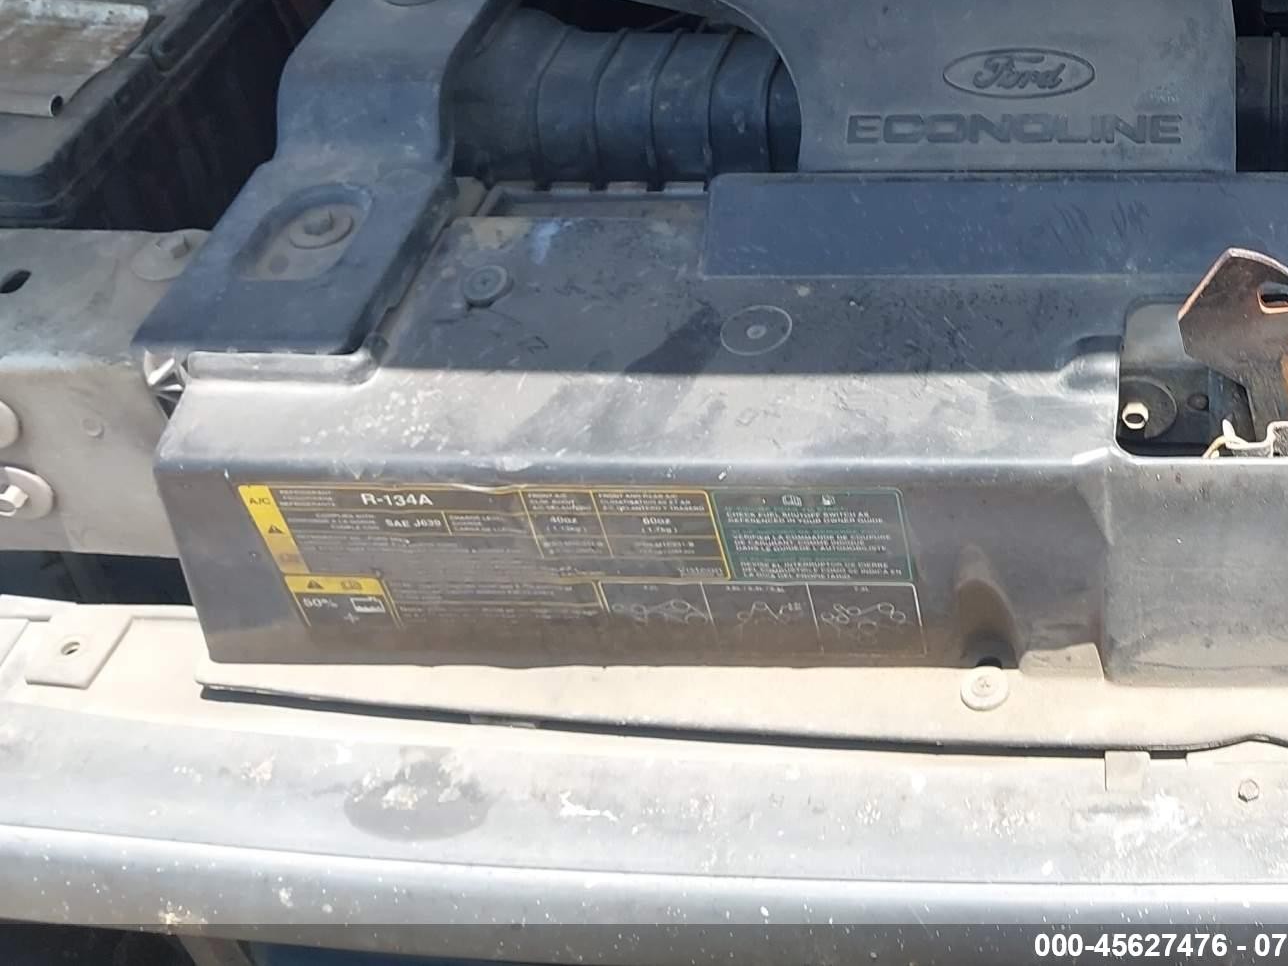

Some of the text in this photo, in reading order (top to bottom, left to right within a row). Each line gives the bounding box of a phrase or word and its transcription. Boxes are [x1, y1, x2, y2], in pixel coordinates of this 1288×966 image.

[974, 54, 1067, 90] Ford
[847, 113, 1184, 144] ECONOLINE
[249, 497, 271, 505] A/C
[361, 493, 433, 506] R-134A
[384, 518, 411, 528] SAE
[414, 518, 442, 528] J639
